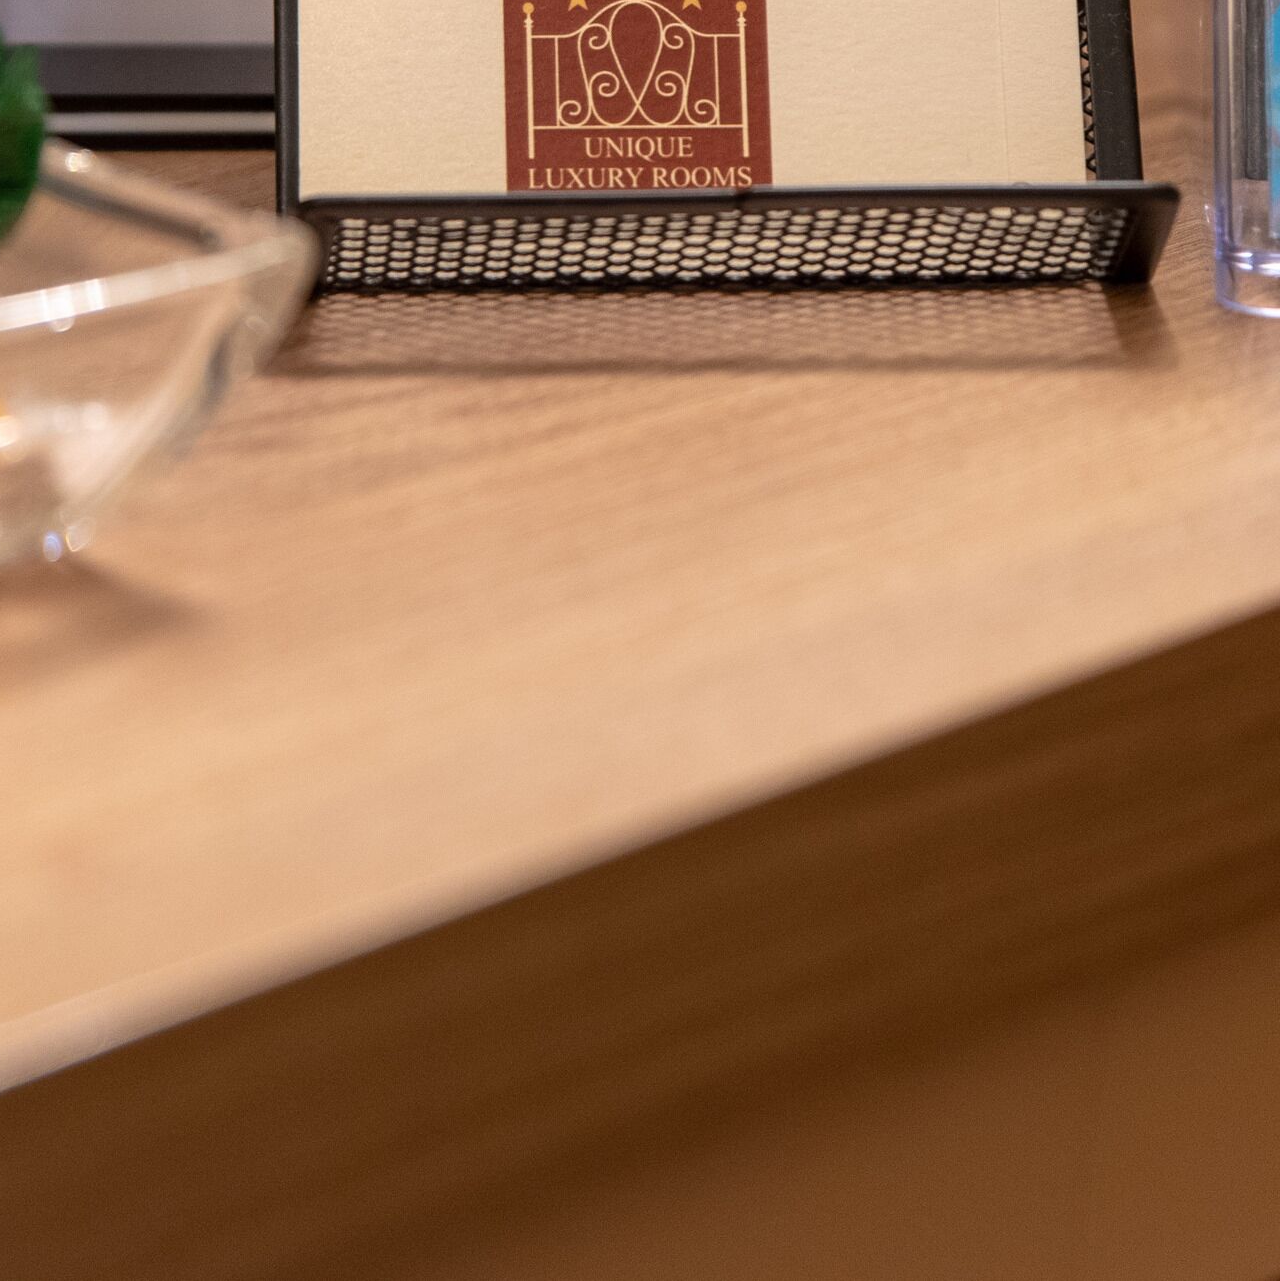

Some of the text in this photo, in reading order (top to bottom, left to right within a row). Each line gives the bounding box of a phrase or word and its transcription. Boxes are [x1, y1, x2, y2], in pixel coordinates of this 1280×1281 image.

[584, 136, 694, 162] UNIQUE
[528, 166, 753, 190] LUXURY ROOMS
